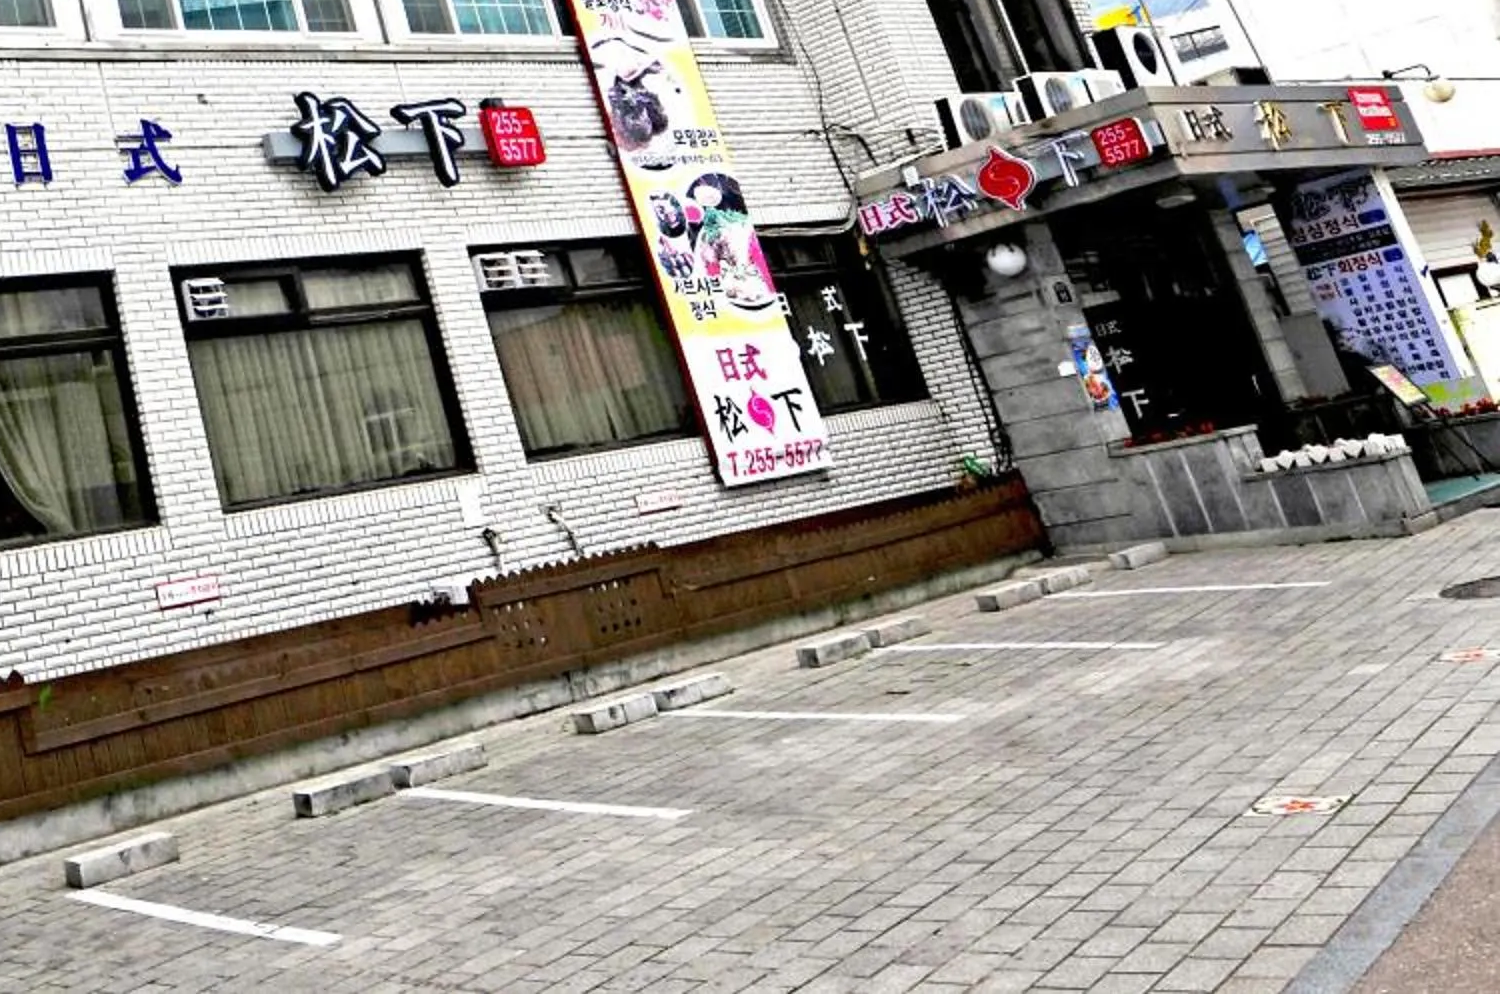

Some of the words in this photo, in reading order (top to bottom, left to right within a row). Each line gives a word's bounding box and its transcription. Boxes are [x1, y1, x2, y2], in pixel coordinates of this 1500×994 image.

[5, 119, 183, 188] 日式
[290, 89, 468, 193] 松下
[494, 110, 530, 134] 255-
[1097, 125, 1134, 148] 255-
[501, 135, 539, 162] 5577
[1104, 138, 1143, 165] 5577
[858, 193, 919, 235] 日式
[691, 300, 718, 322] 정식
[715, 343, 768, 383] 日式
[807, 322, 869, 366] 松下
[713, 387, 803, 444] 松下
[725, 438, 824, 478] T.255-5577
